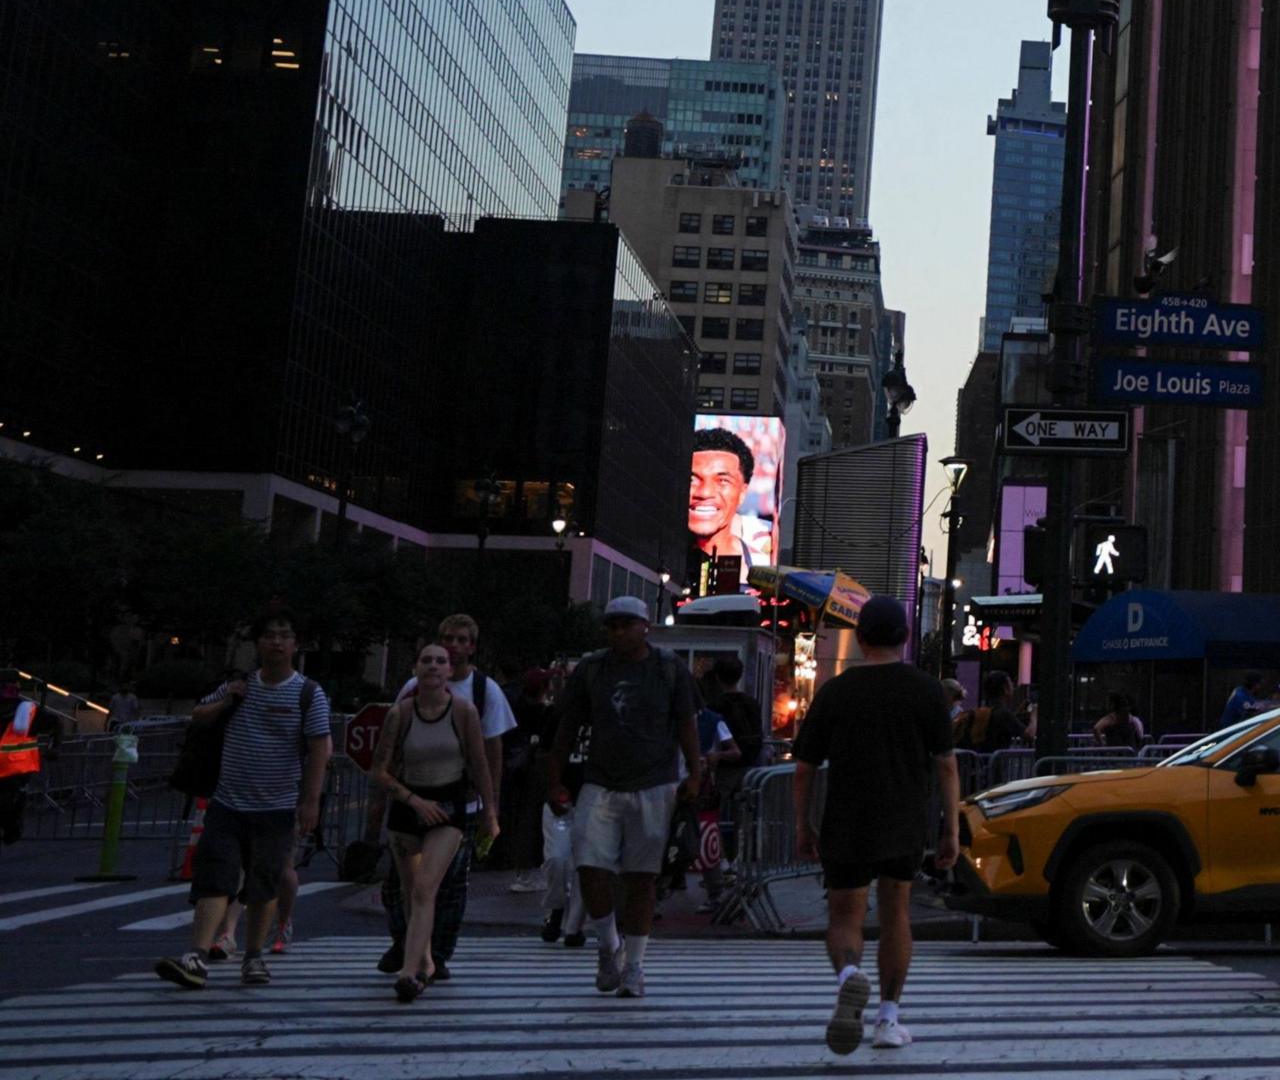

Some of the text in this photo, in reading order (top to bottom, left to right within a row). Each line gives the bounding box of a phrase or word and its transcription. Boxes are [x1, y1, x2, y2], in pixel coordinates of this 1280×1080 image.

[1115, 308, 1250, 338] Eighth Ave
[1113, 369, 1250, 395] Joe Louis Plaza
[1025, 421, 1110, 437] ONE WAY
[1127, 602, 1144, 633] D
[1130, 637, 1169, 649] ENTRANCE
[351, 725, 379, 751] ST
